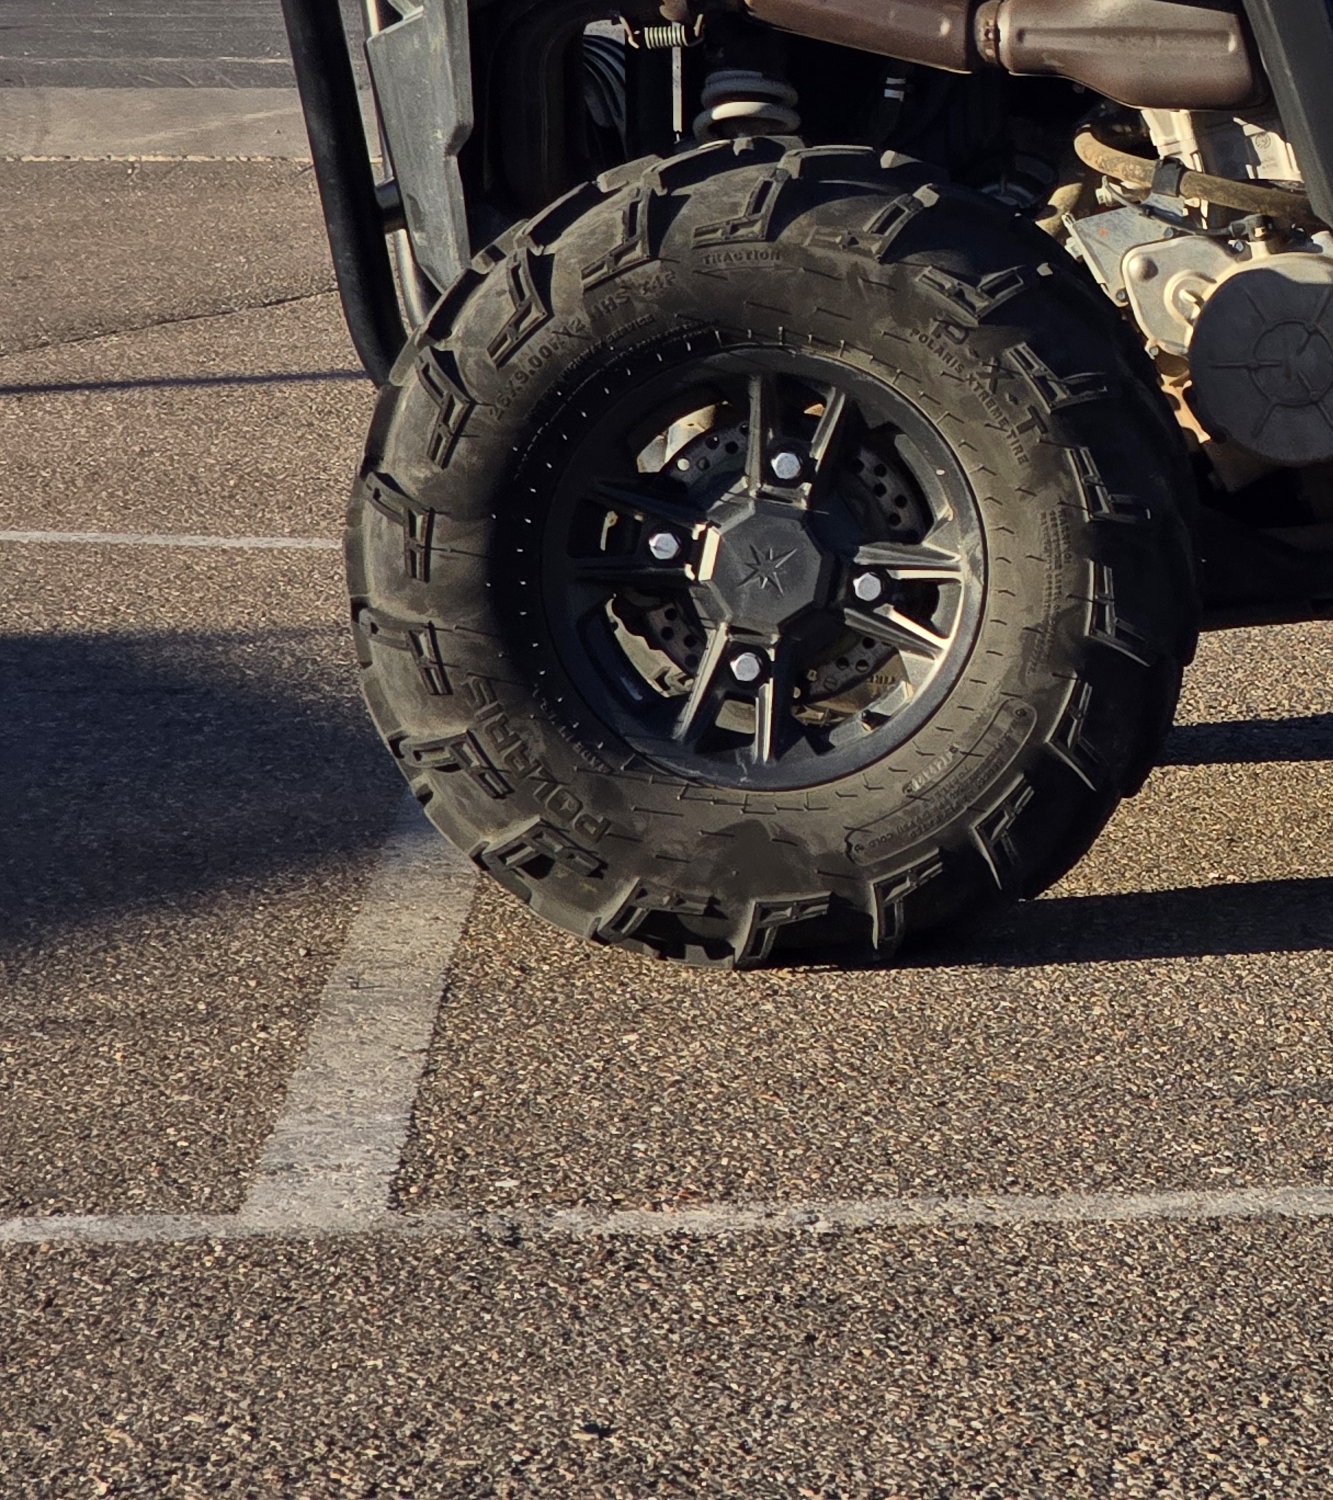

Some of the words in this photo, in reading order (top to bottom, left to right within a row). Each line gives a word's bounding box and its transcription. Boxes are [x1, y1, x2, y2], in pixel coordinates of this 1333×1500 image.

[701, 249, 780, 267] TRACTION
[908, 325, 966, 375] POLARIS
[962, 372, 1009, 428] XTREME
[1003, 429, 1029, 466] TIRE
[460, 673, 612, 845] POLARIS
